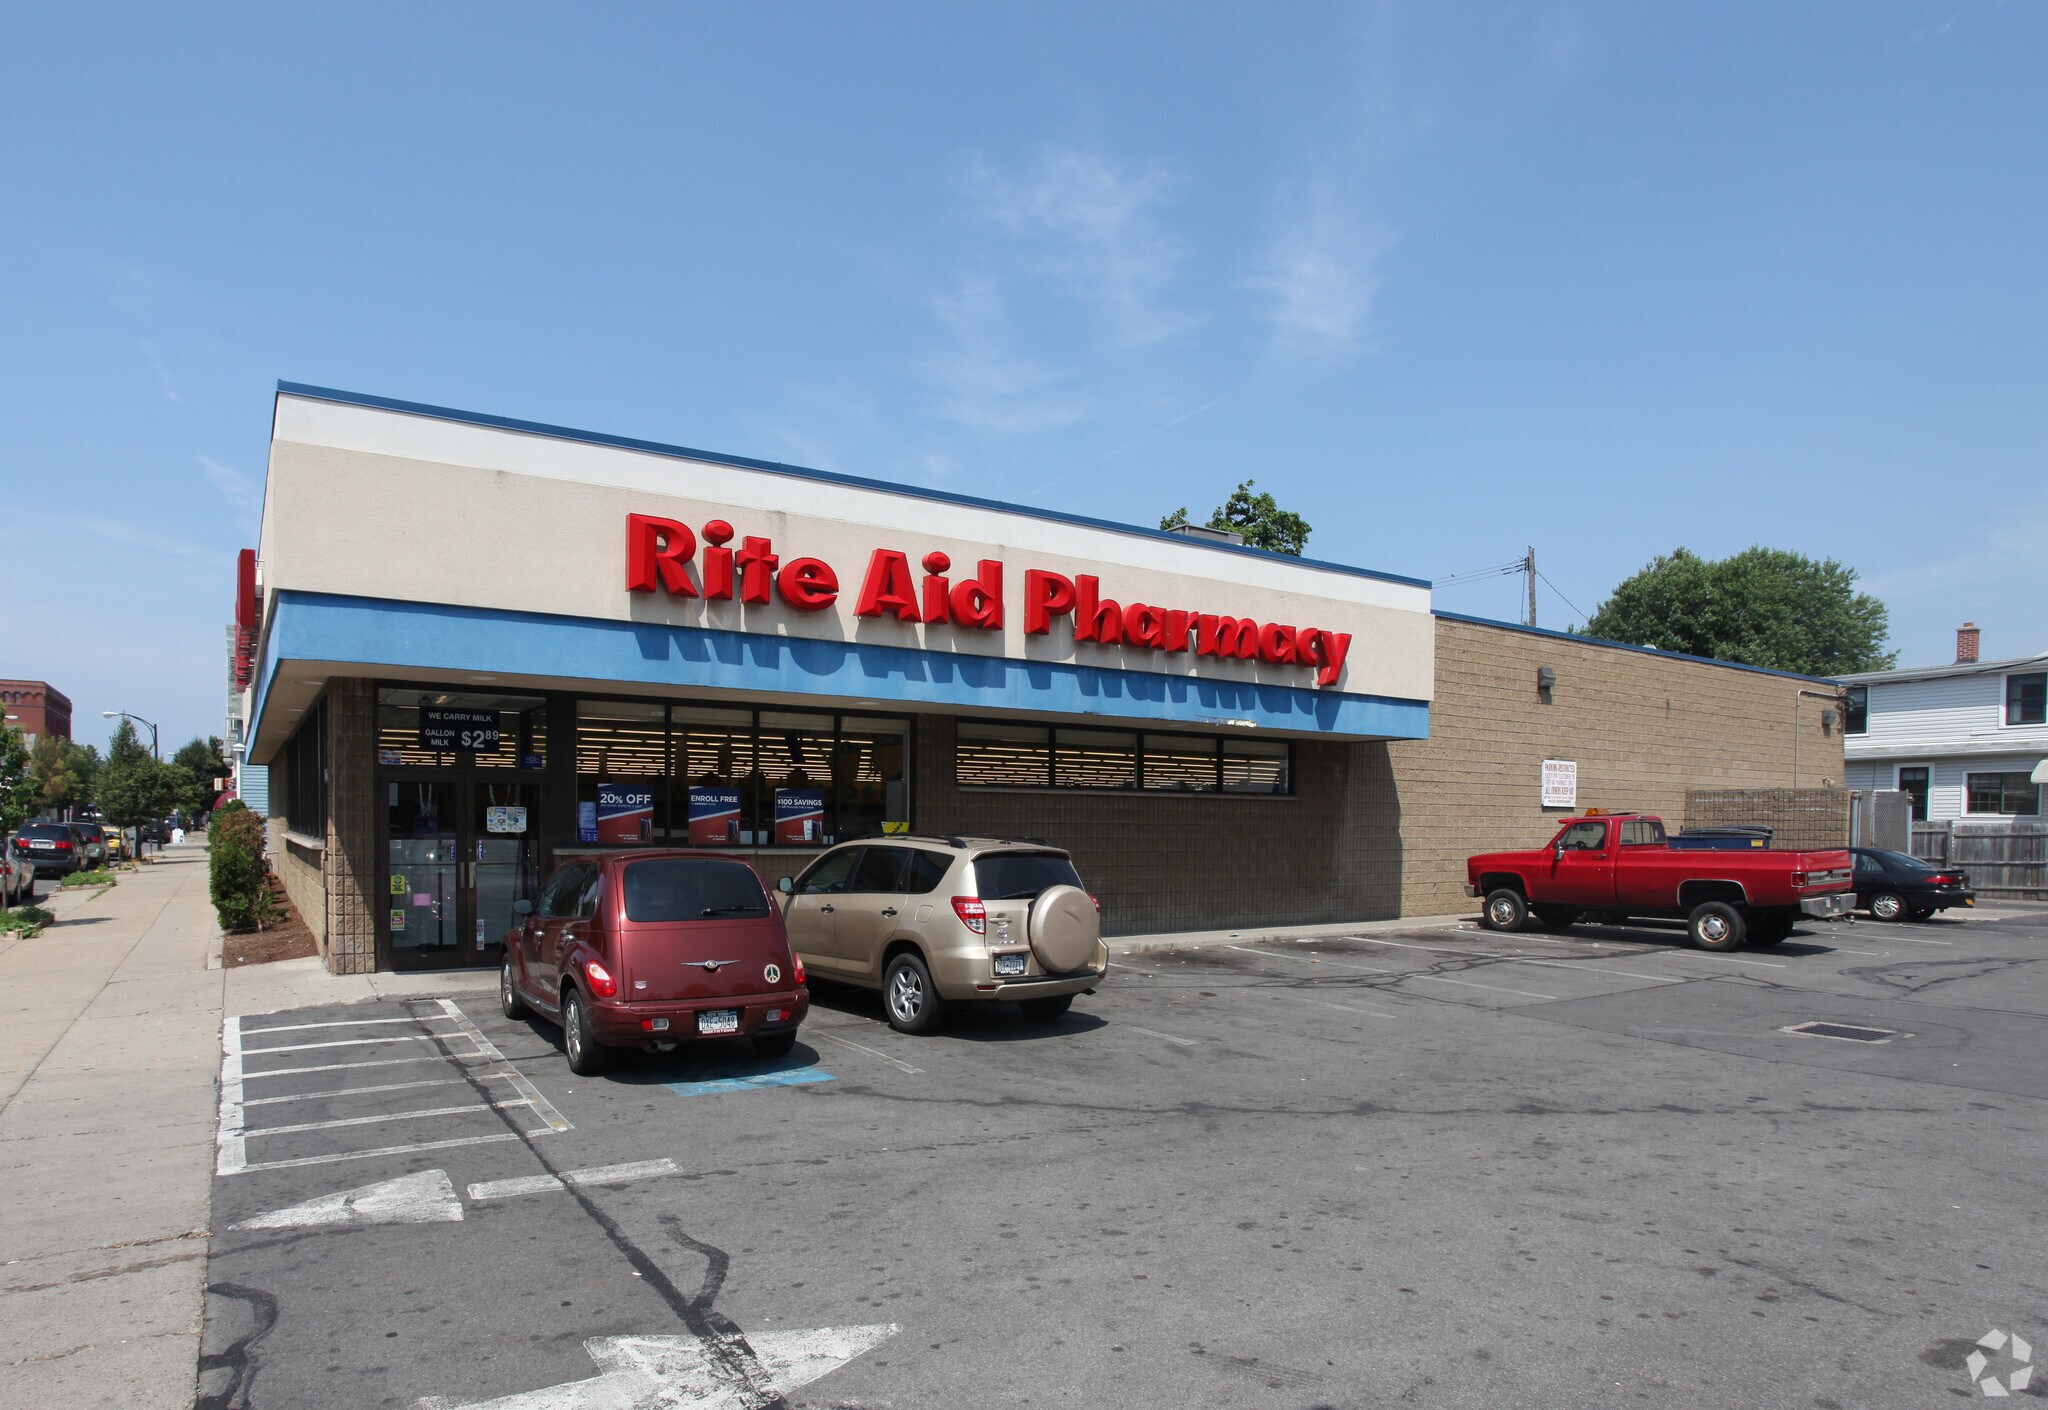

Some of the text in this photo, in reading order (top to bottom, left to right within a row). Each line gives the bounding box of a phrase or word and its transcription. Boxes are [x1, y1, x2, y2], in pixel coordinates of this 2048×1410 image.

[626, 512, 1352, 686] Rite Aid Pharmacy
[428, 712, 492, 722] WE CARRY MILK
[425, 728, 455, 737] GALLON
[430, 738, 449, 746] MILK
[600, 793, 651, 804] 20% OFF
